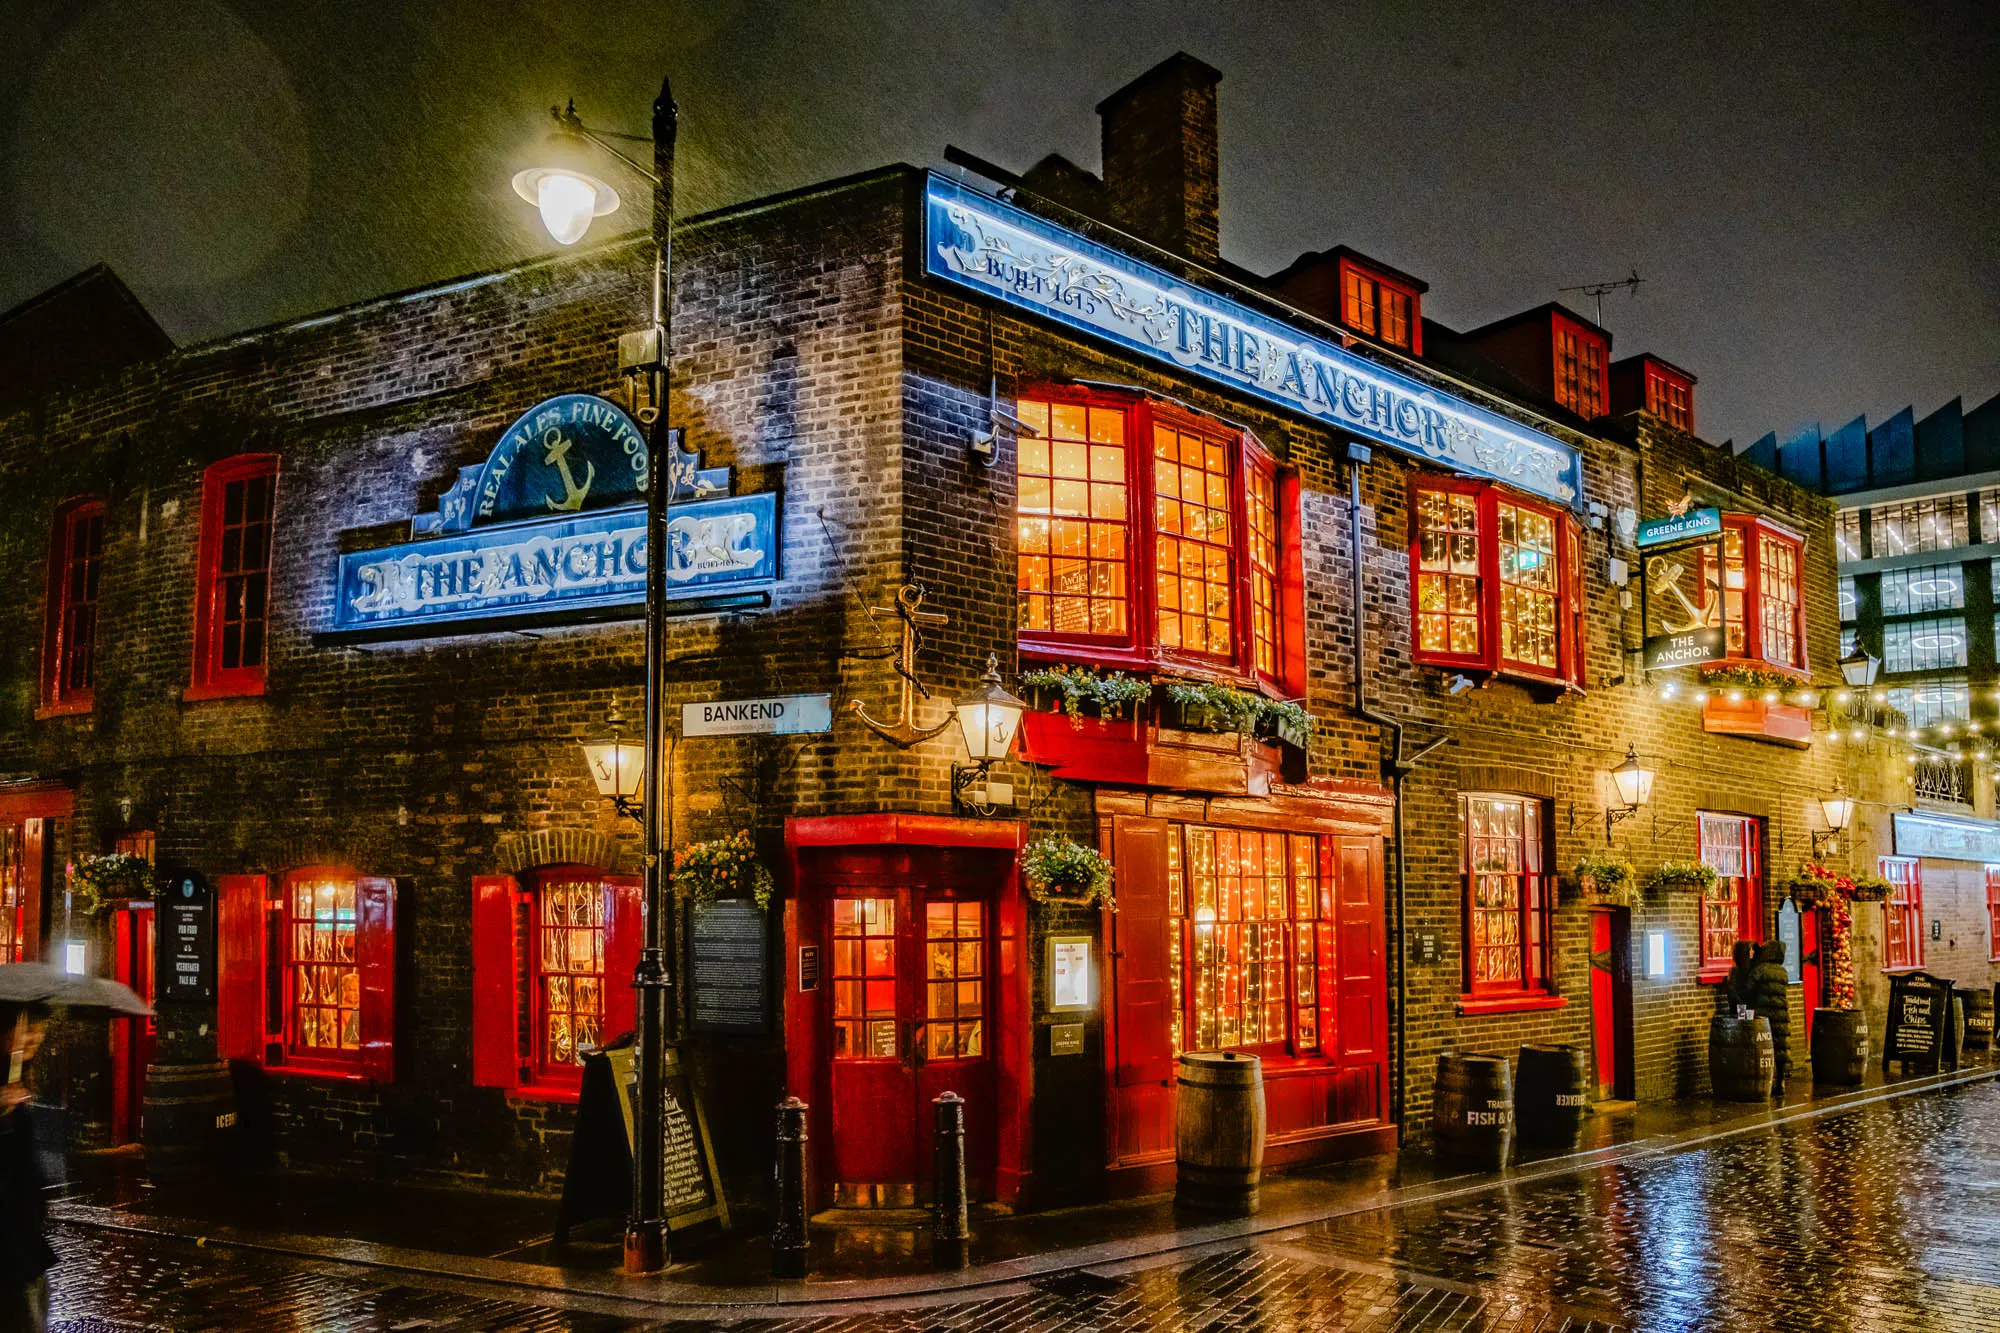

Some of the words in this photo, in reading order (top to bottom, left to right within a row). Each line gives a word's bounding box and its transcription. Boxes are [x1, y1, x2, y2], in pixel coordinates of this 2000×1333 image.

[986, 253, 1046, 295] BUILT
[1054, 281, 1096, 316] 1615
[1168, 303, 1261, 382] THE
[1279, 350, 1449, 450] ANCHOR
[479, 455, 514, 518] REAL
[514, 406, 561, 453] ALES
[571, 402, 617, 432] FINE
[612, 421, 649, 493] FOOD
[1646, 520, 1684, 538] GREENE
[1685, 516, 1712, 530] KING
[410, 553, 485, 600] THE
[500, 527, 694, 590] ANCHOR
[1670, 635, 1695, 649] THE
[1656, 645, 1711, 663] ANCHOR
[703, 702, 785, 722] BANKEND
[1467, 1111, 1496, 1126] FISH
[1498, 1112, 1505, 1125] &
